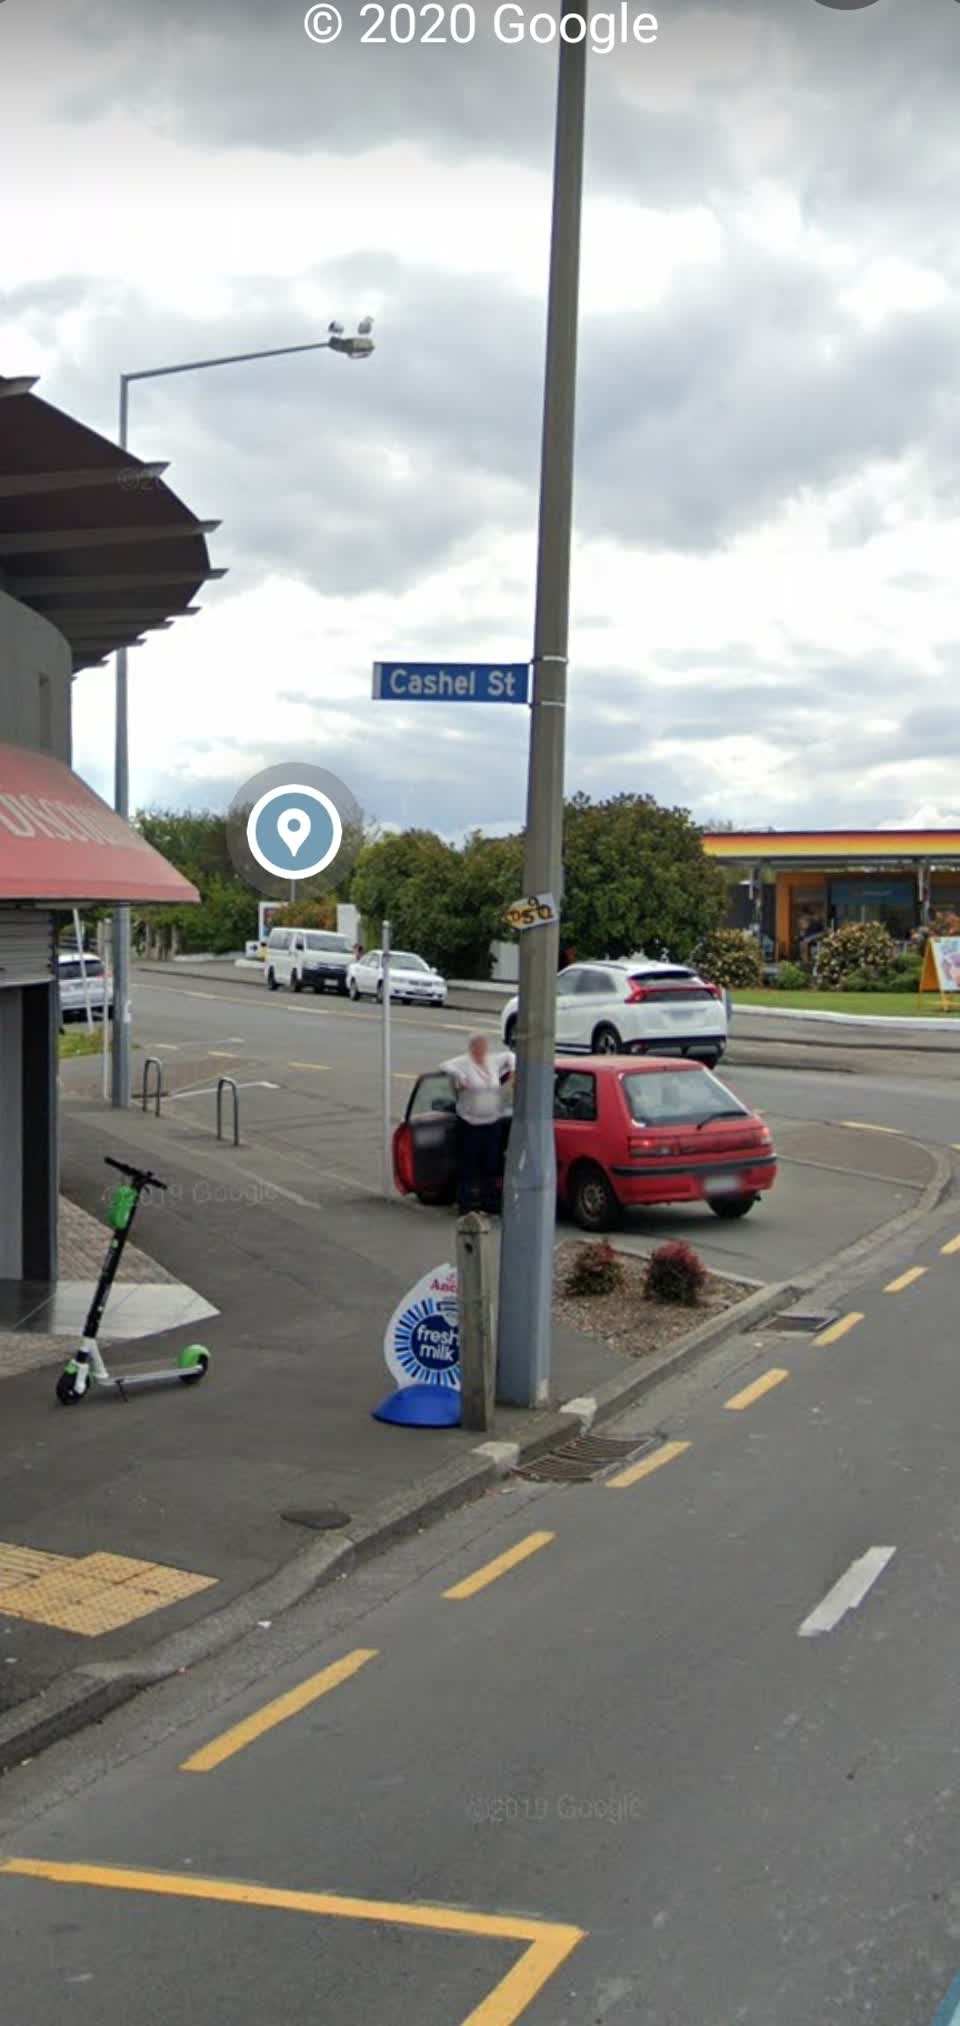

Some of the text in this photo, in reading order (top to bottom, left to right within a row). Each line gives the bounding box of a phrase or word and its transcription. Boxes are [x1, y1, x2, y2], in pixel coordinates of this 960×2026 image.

[389, 669, 516, 697] Cashel St
[418, 1324, 458, 1345] fresh
[420, 1343, 455, 1361] milk
